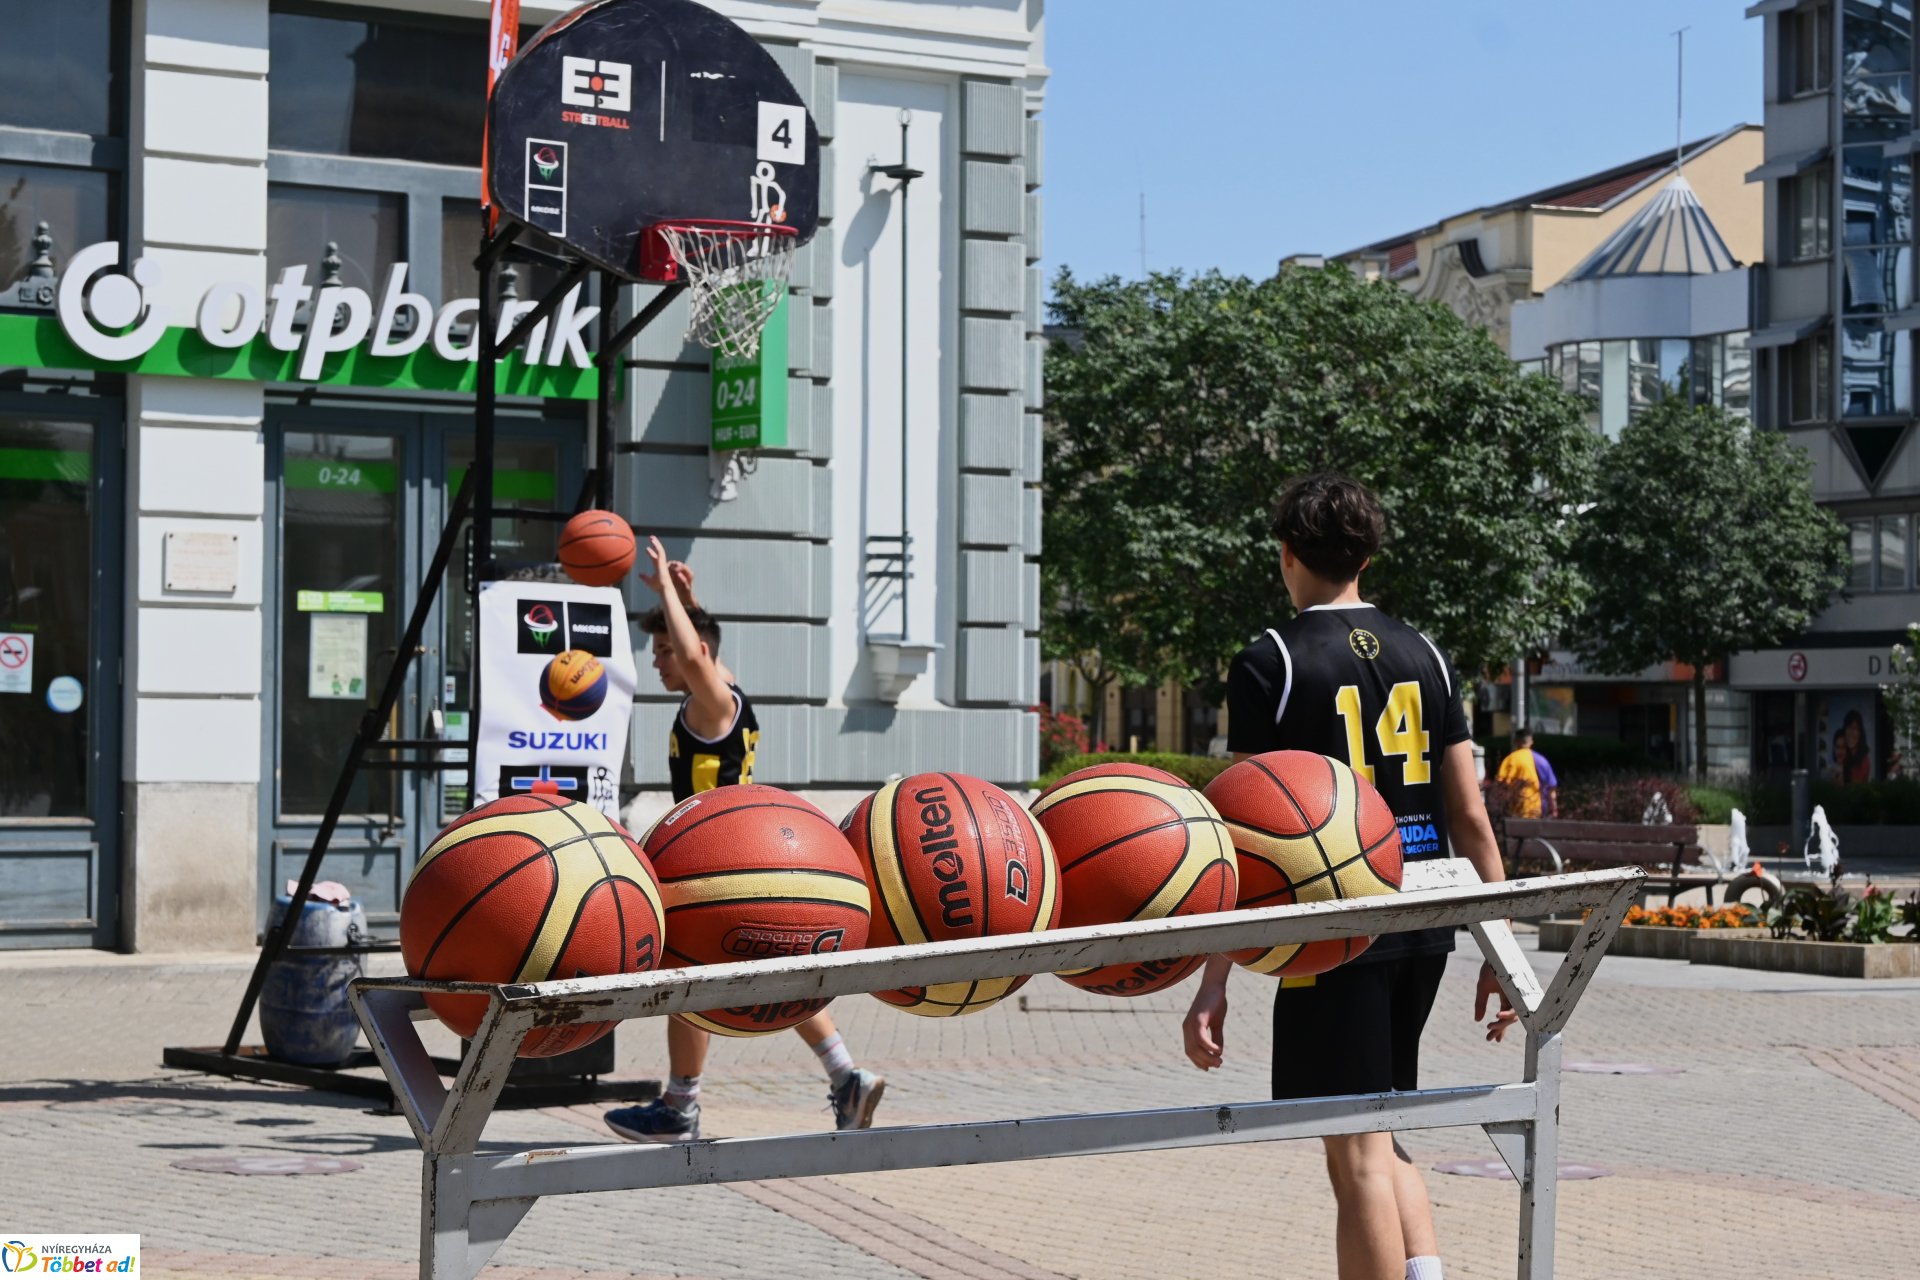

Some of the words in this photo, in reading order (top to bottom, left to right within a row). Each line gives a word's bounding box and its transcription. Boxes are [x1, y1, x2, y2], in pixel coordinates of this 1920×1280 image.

[771, 118, 793, 149] 4
[196, 262, 601, 380] otpbank
[717, 378, 756, 410] 0-24
[318, 466, 361, 487] 0-24
[508, 731, 607, 751] SUZUKI
[1335, 681, 1431, 786] 14
[915, 786, 974, 928] molten
